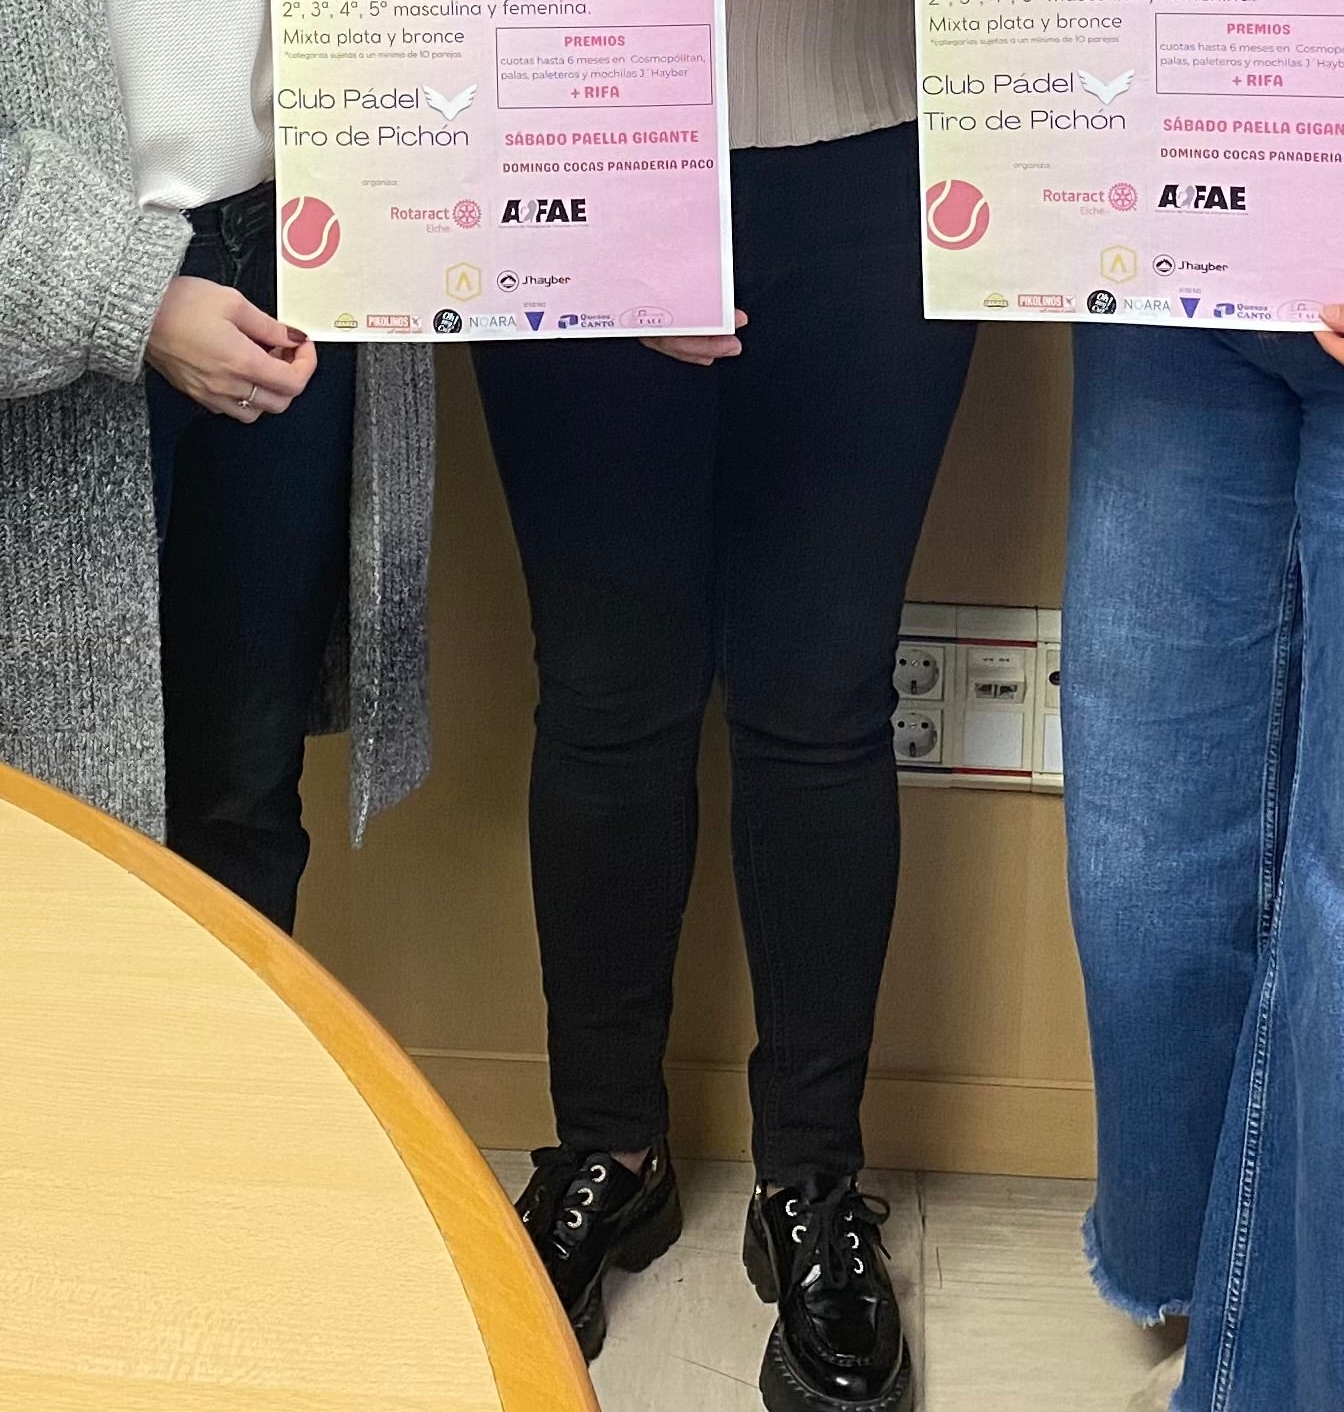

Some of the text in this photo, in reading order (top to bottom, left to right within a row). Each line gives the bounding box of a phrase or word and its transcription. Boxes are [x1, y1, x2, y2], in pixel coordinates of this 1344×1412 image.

[394, 0, 482, 16] masculina
[487, 4, 497, 19] y
[502, 0, 591, 16] femenina.
[929, 13, 1123, 33] Mixta plata y bronce
[1227, 23, 1291, 35] PREMIOS
[283, 28, 465, 47] Mixta plata y bronce
[564, 35, 626, 47] PREMIOS
[1159, 43, 1196, 51] cuotas
[1198, 42, 1227, 52] hasta
[1229, 43, 1237, 52] 6
[1239, 44, 1275, 53] meses
[1276, 45, 1290, 53] en
[500, 56, 535, 66] cuotas
[537, 55, 565, 65] hasta
[567, 55, 574, 65] 6
[576, 57, 610, 65] meses
[612, 56, 626, 64] en
[1192, 57, 1242, 67] paleteros
[1244, 59, 1251, 68] y
[1253, 58, 1303, 67] mochilas
[532, 70, 580, 81] paleteros
[582, 72, 588, 81] y
[590, 69, 638, 79] mochilas
[1232, 74, 1284, 87] + RIFA
[922, 72, 1074, 95] Club Pádel
[277, 87, 419, 110] Club Pádel
[570, 85, 620, 99] + RIFA
[922, 108, 1126, 131] Tiro de Pichón
[1163, 117, 1227, 133] SÁBADO
[1232, 120, 1291, 134] PAELLA
[278, 124, 469, 147] Tiro de Pichón
[504, 130, 700, 146] SÁBADO PAELLA GIGANTE
[1160, 148, 1219, 159] DOMINGO
[1223, 149, 1265, 161] COCAS
[1269, 151, 1342, 163] PANADERIA
[503, 159, 714, 173] DOMINGO COCAS PANADERIA PACO
[1043, 188, 1105, 202] Rotaract
[390, 206, 450, 220] Rotaract
[426, 224, 450, 234] Elche
[1019, 295, 1062, 307] PIKOLINOS
